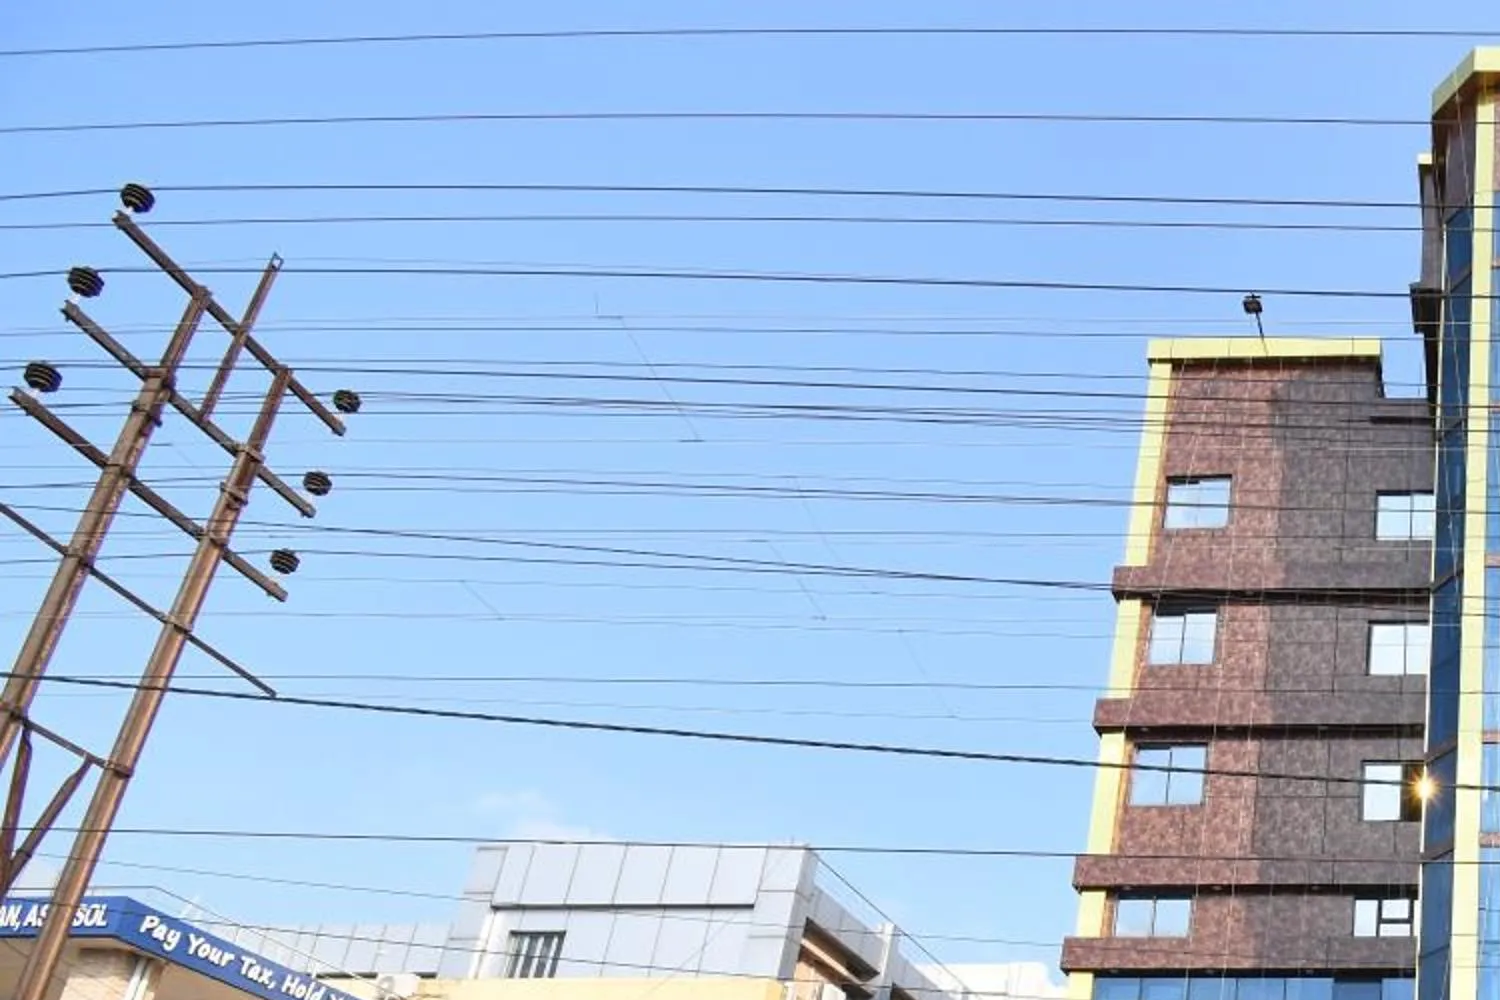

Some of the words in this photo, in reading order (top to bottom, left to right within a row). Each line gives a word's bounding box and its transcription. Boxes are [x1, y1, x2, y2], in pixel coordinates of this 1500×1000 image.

[23, 903, 107, 927] ASSOL
[140, 915, 181, 951] Pay
[188, 933, 235, 967] Your
[241, 955, 277, 989] Tax,
